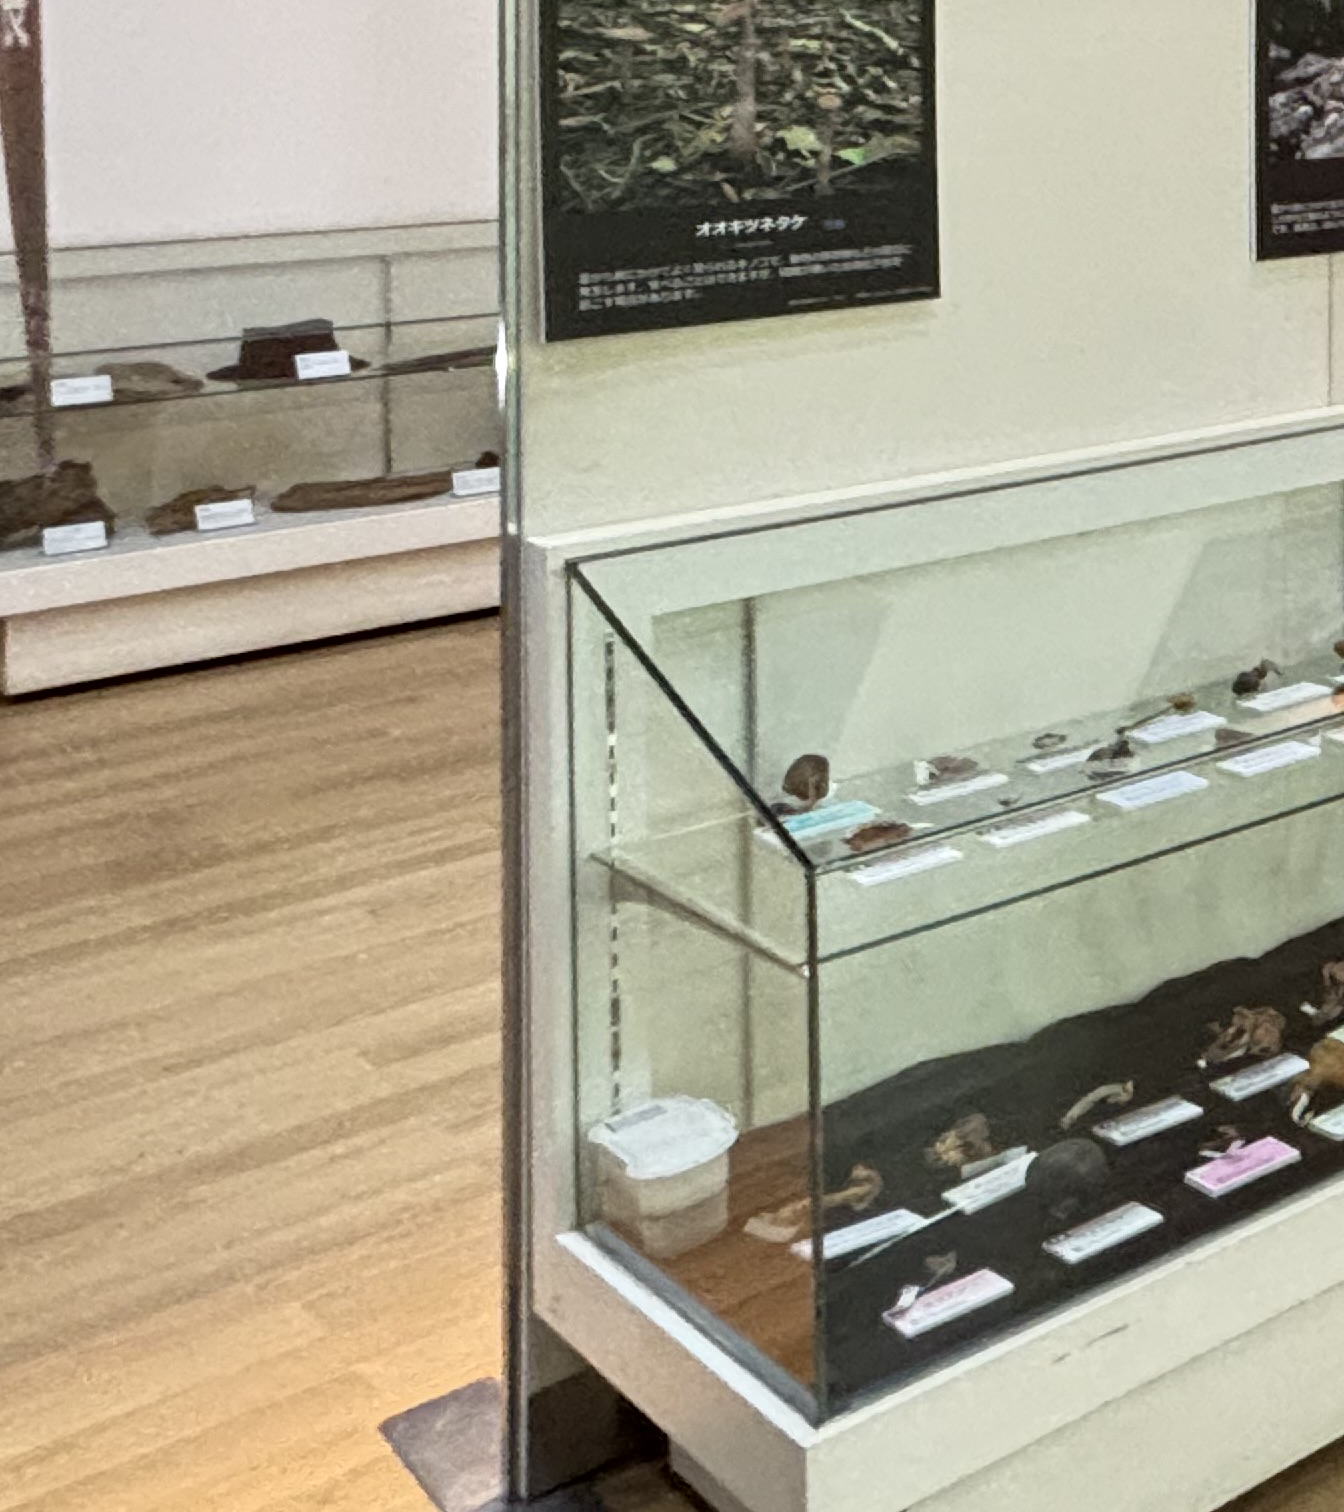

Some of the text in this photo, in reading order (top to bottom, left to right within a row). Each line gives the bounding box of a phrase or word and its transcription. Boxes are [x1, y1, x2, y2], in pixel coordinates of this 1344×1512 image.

[695, 214, 808, 237] オオキツネタケ
